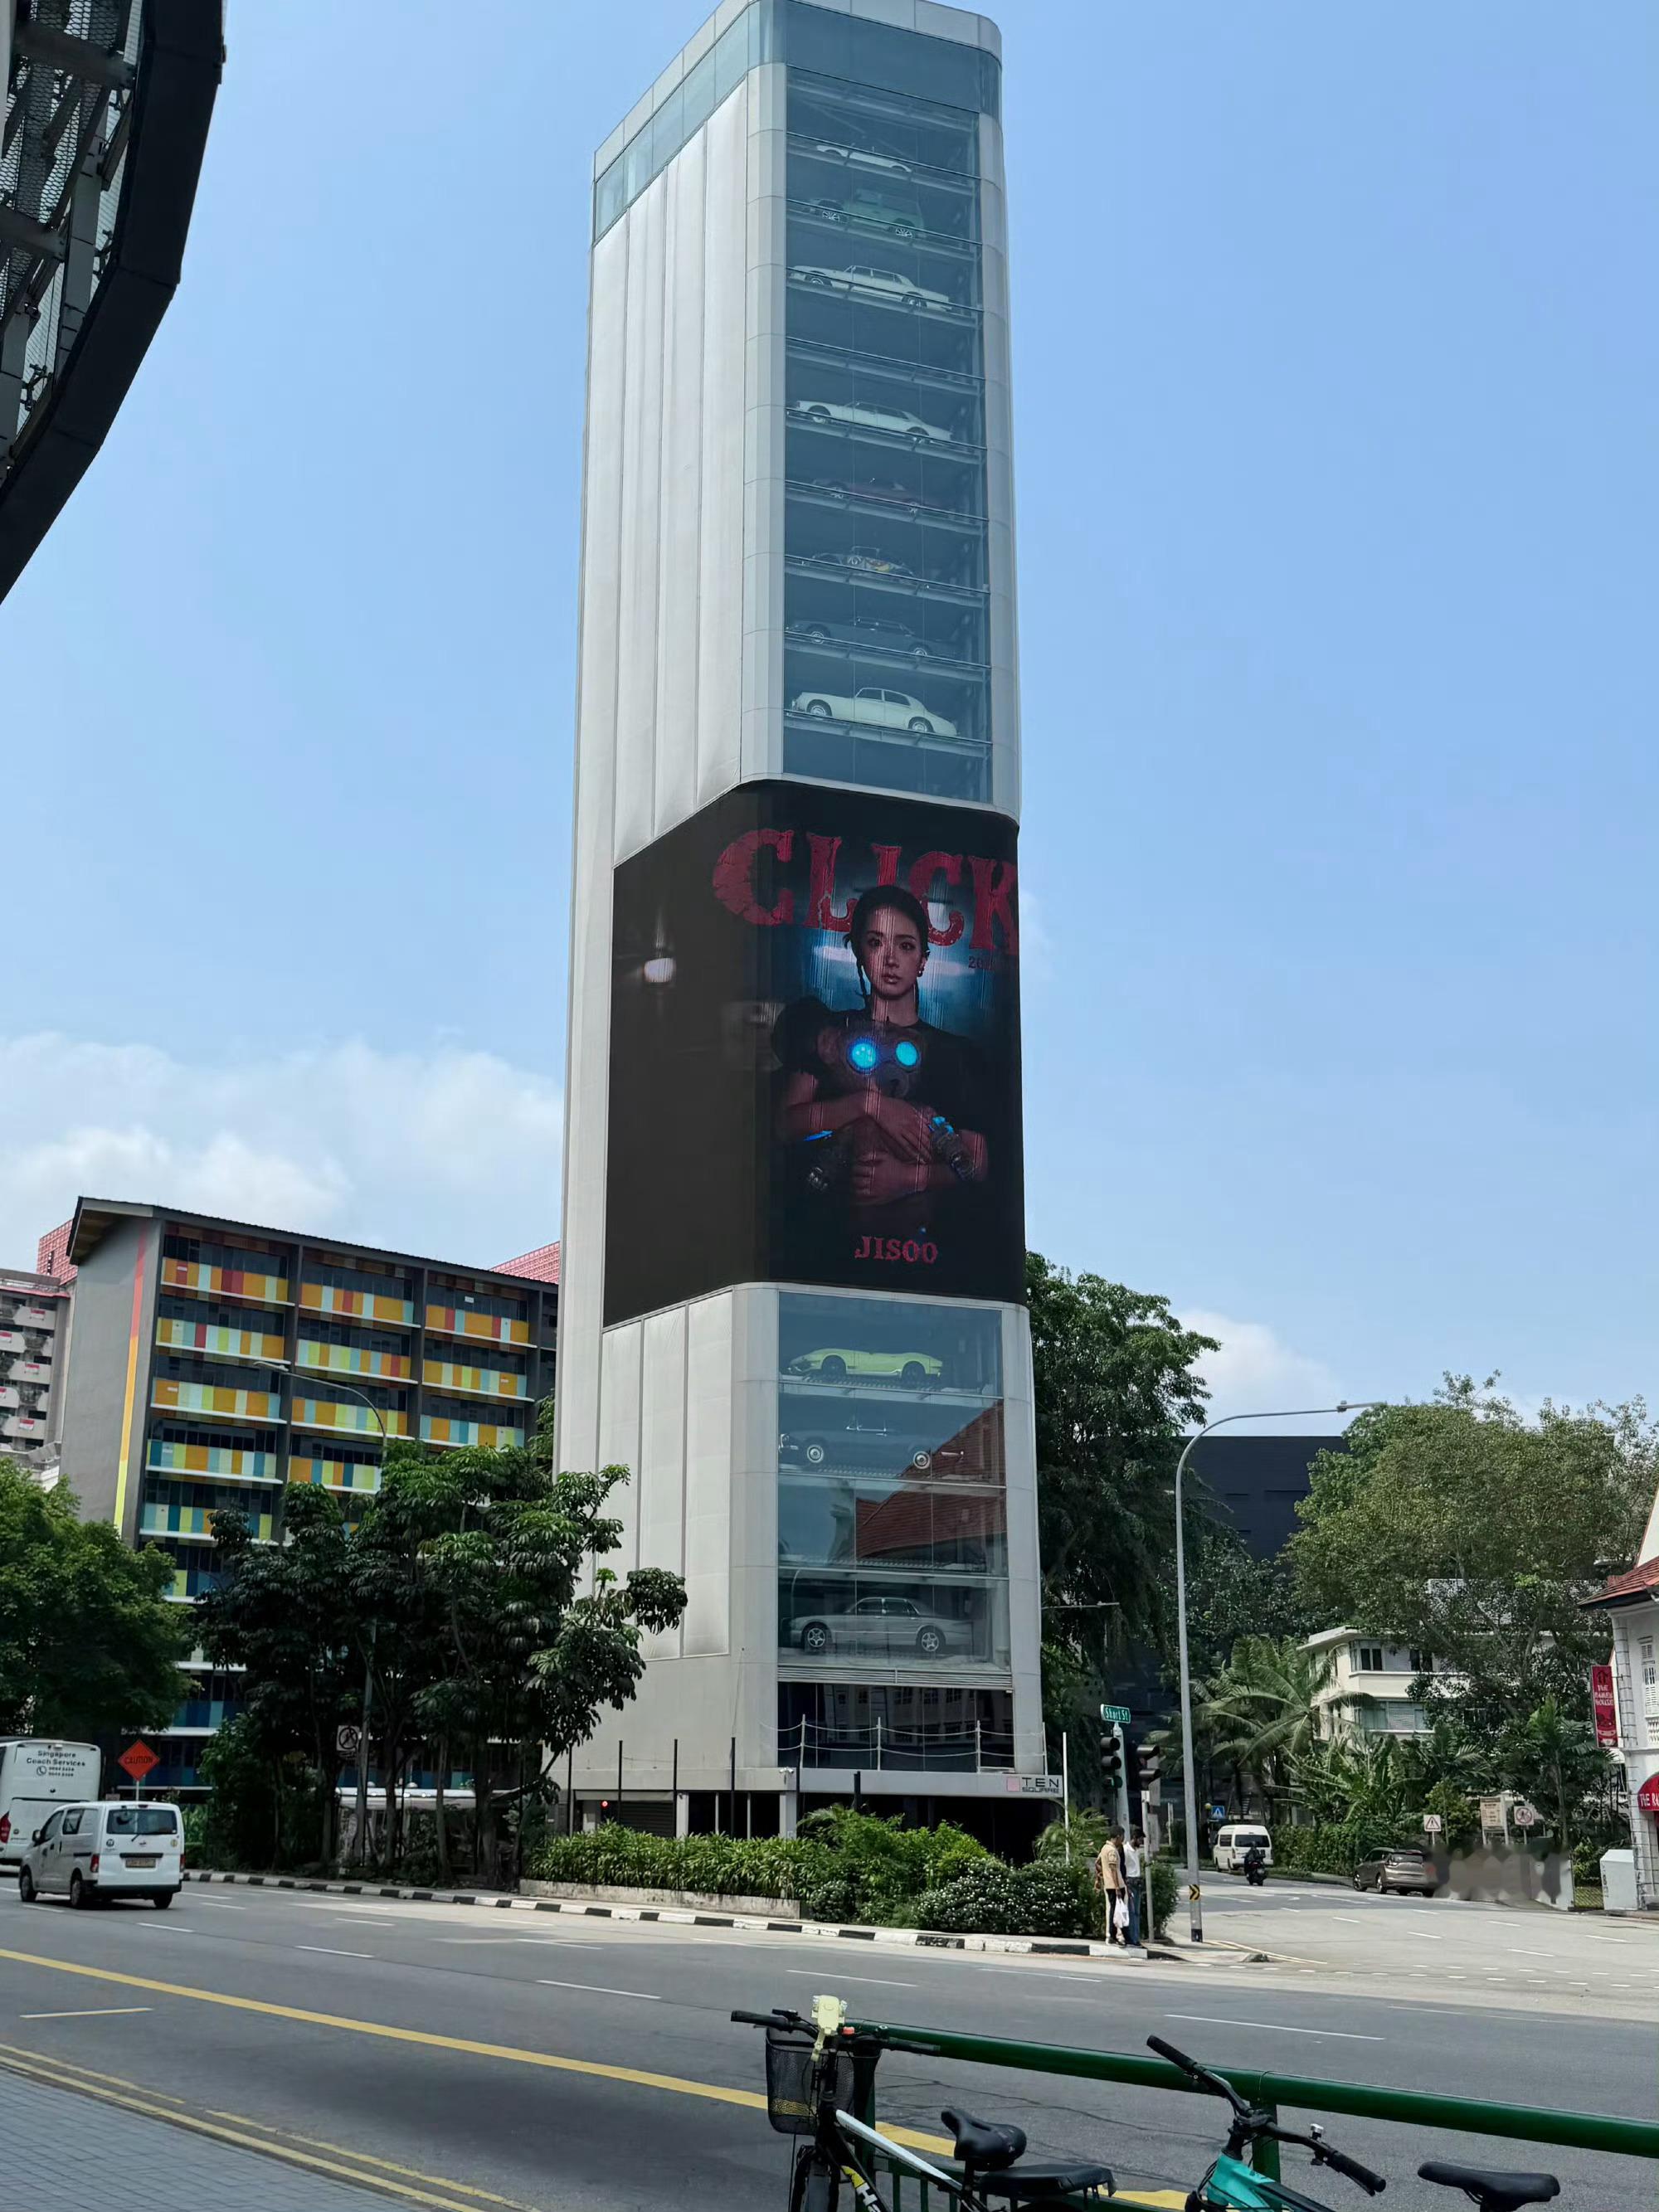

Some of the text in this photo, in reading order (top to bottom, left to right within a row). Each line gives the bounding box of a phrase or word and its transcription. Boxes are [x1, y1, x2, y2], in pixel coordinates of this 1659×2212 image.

[854, 1236, 938, 1264] JISOO
[52, 1758, 85, 1767] Services
[124, 1755, 153, 1765] CAUTION
[1021, 1777, 1059, 1787] TEN
[1639, 1793, 1651, 1806] THE
